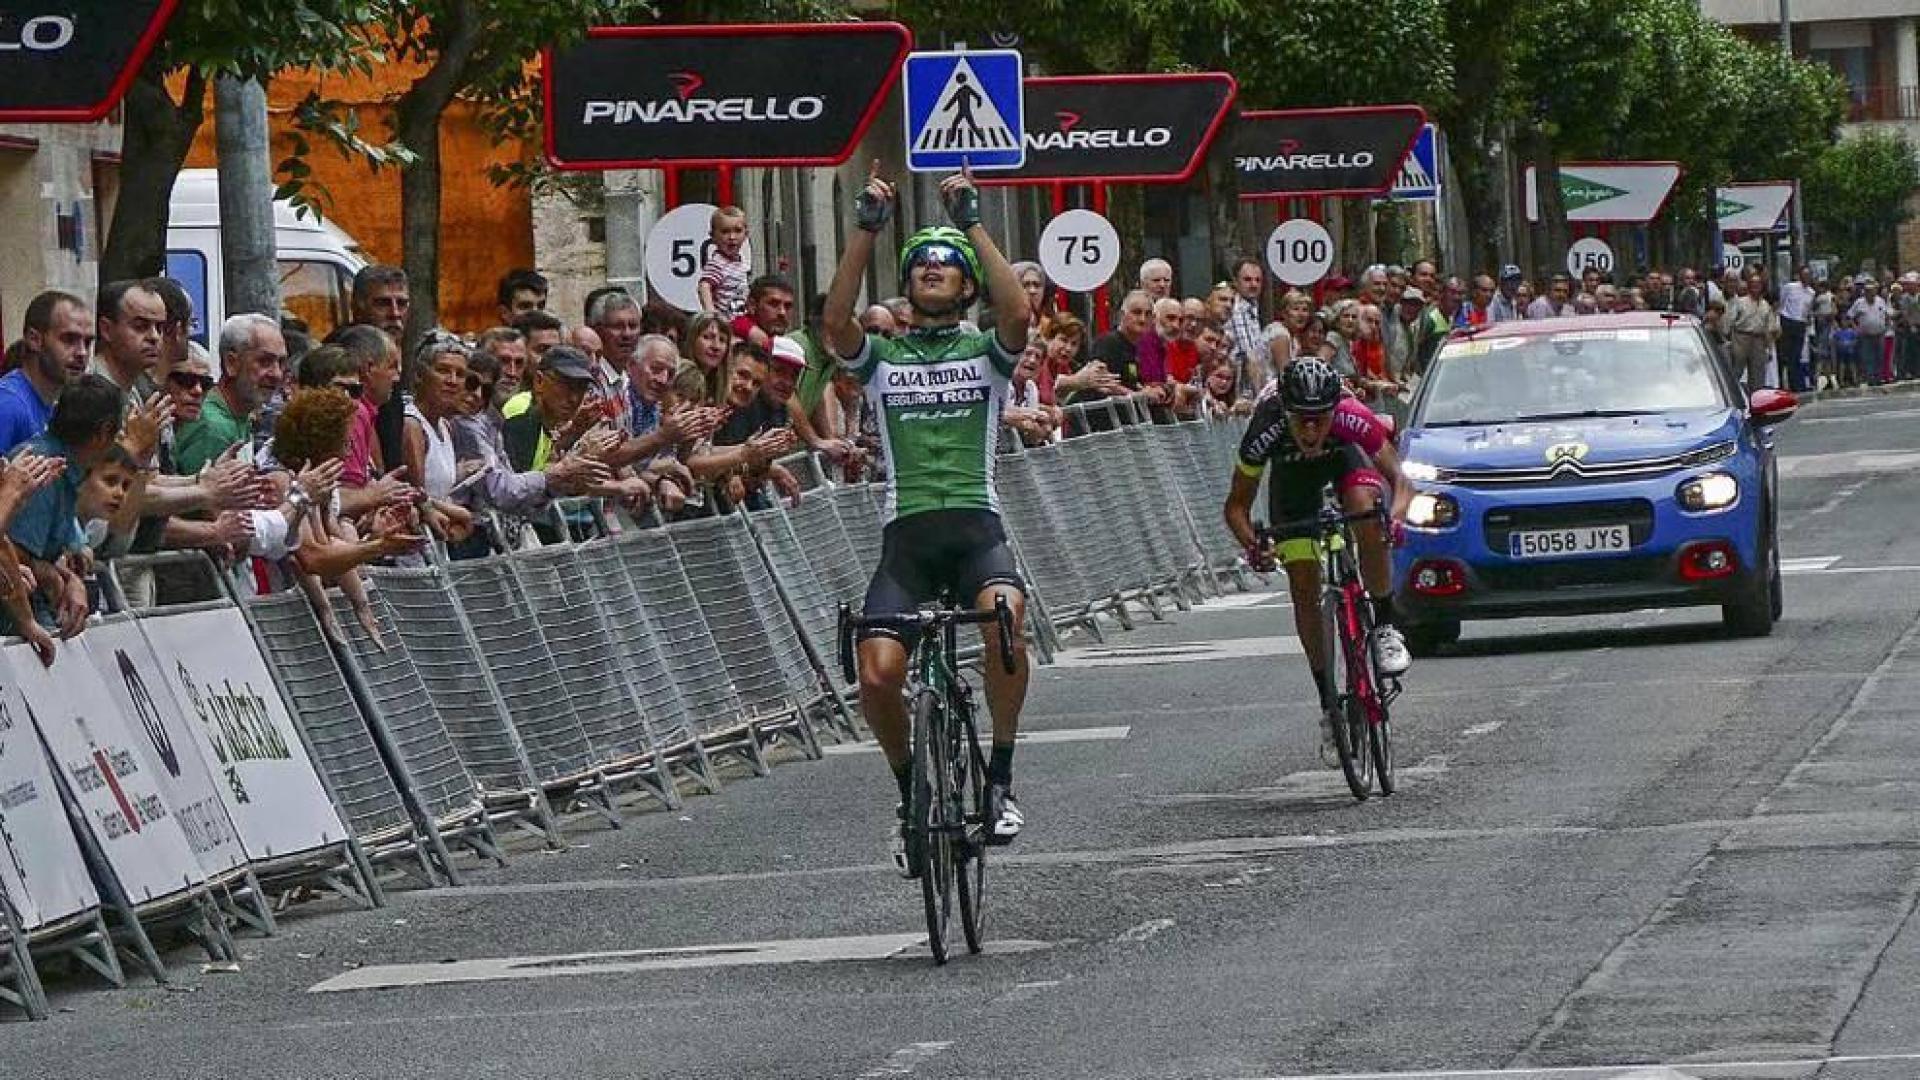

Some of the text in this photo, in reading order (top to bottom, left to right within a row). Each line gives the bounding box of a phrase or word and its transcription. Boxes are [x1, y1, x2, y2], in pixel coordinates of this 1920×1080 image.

[583, 96, 824, 125] PINARELLO
[1058, 235, 1101, 264] 75
[1275, 239, 1326, 263] 100
[1574, 252, 1609, 270] 150
[888, 366, 982, 386] CAJA RURAL
[886, 389, 983, 406] SEGUROS RGA
[1524, 529, 1623, 553] 5058 JYS
